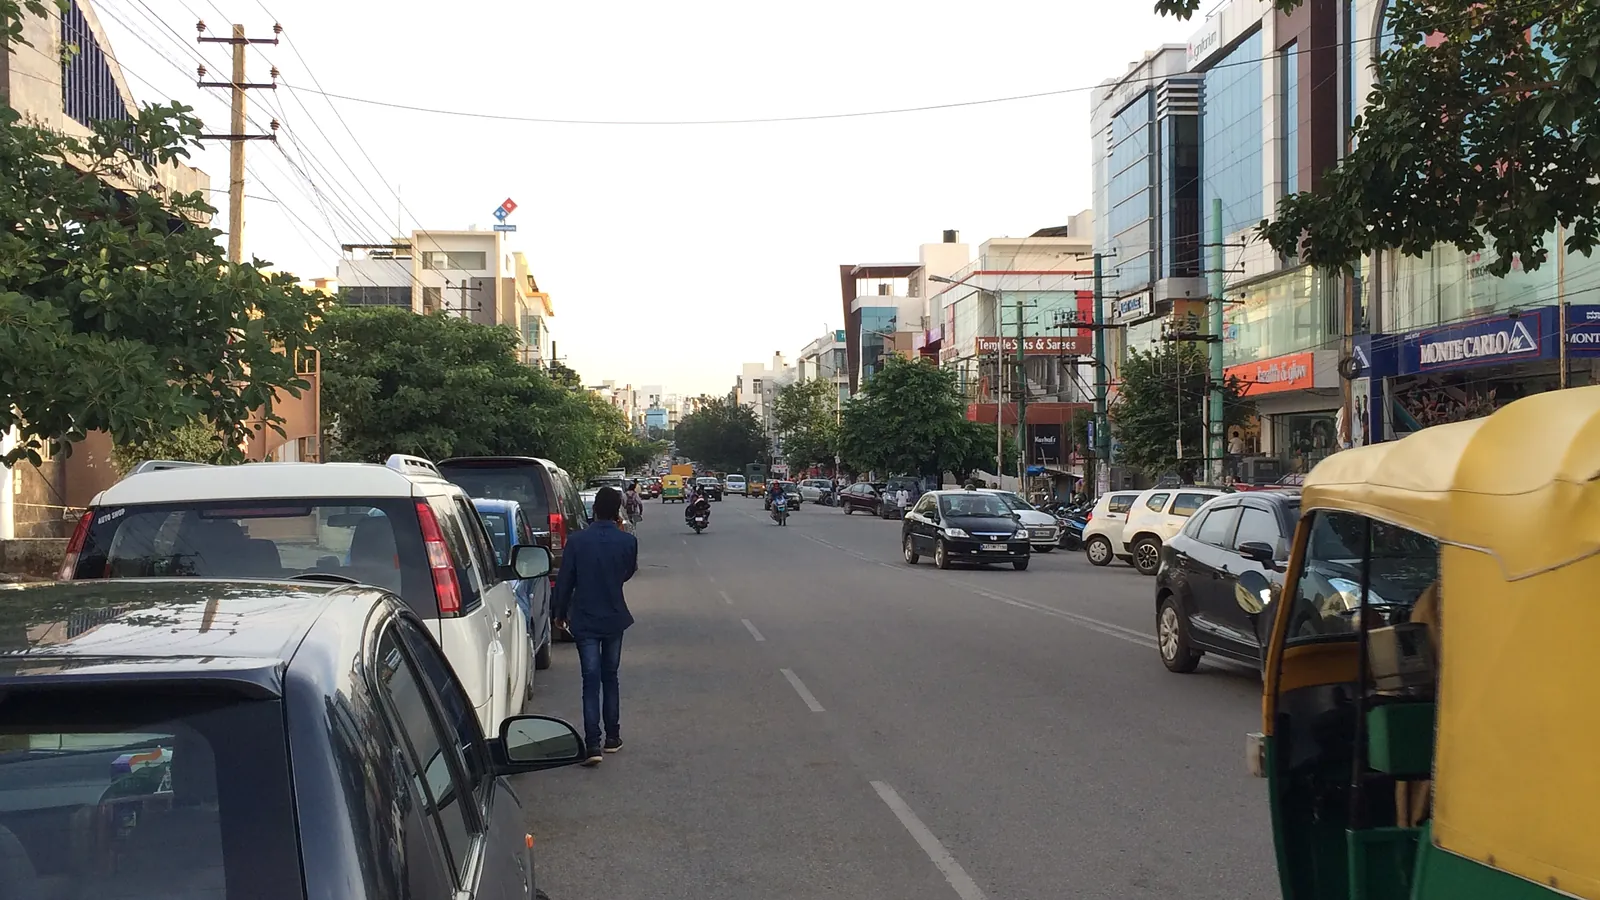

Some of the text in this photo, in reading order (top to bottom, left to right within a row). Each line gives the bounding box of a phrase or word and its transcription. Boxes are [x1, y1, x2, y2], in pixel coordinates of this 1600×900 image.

[1012, 338, 1034, 350] Sks
[1035, 338, 1044, 350] &
[1046, 339, 1076, 350] Sarees
[1420, 331, 1510, 364] MONTE CARLO
[98, 508, 125, 524] AUTO SHOP
